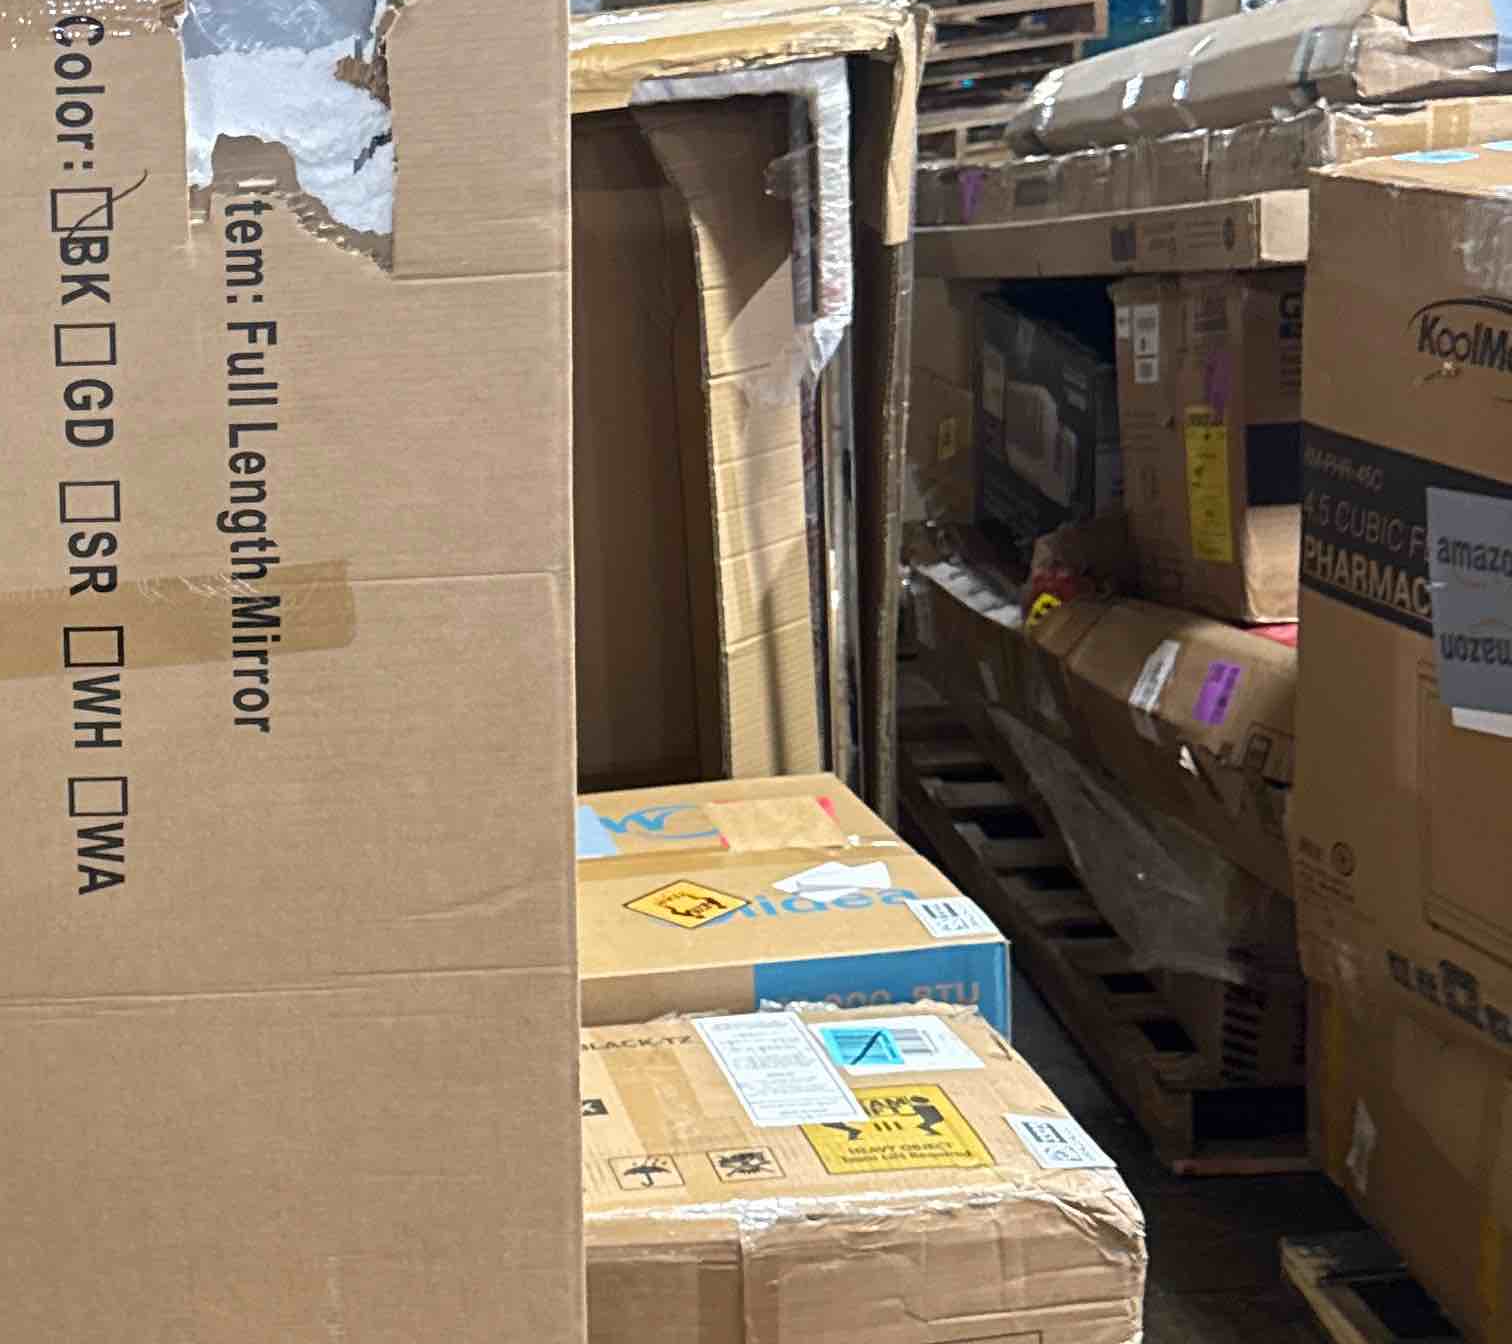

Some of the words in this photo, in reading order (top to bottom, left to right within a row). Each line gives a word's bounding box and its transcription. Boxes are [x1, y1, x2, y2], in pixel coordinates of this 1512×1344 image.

[54, 15, 105, 171] Color:
[60, 235, 111, 306] BK
[224, 200, 273, 303] tem:
[226, 320, 278, 407] Full
[1417, 312, 1512, 373] KoolM
[63, 378, 115, 448] GD
[216, 422, 281, 583] Length
[1336, 500, 1402, 552] CUBIC
[67, 531, 118, 597] SR
[1302, 534, 1432, 616] PHARMAC
[1438, 535, 1512, 577] amazo
[231, 595, 281, 734] Mirror
[1440, 631, 1512, 668] mazon
[72, 673, 123, 749] WH
[77, 821, 126, 895] WA
